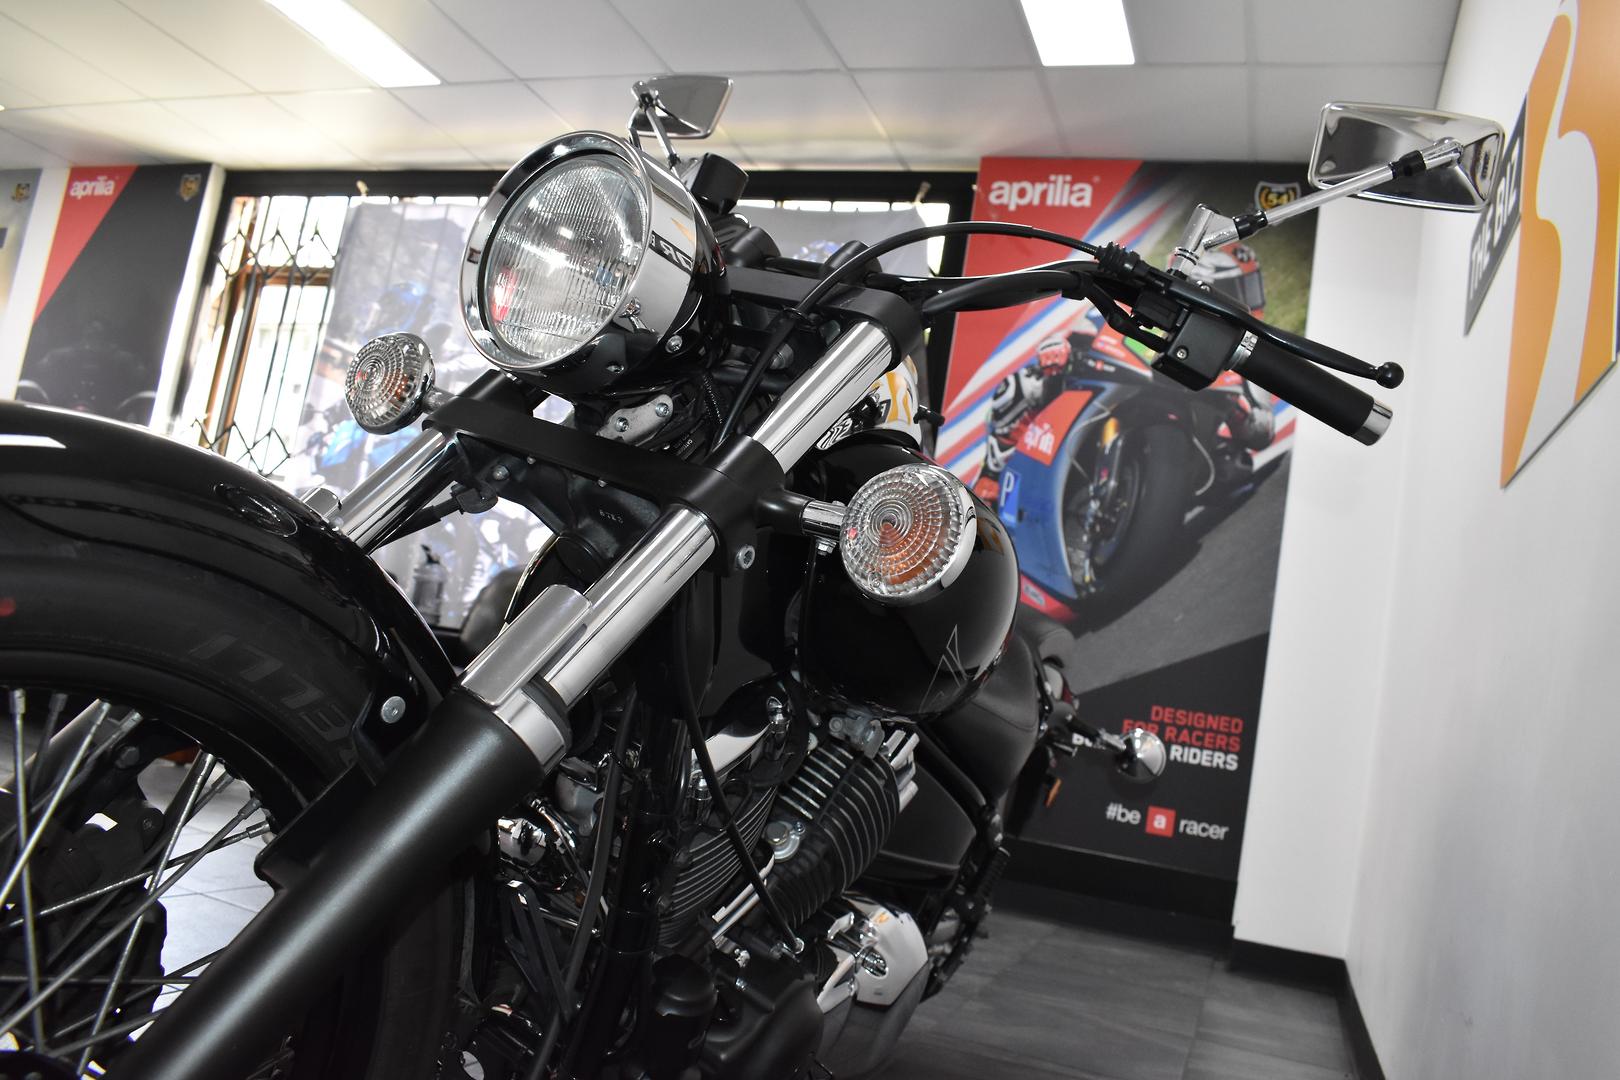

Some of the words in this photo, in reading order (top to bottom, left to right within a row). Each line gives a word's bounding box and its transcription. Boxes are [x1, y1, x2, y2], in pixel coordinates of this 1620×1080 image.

[69, 175, 116, 200] aprilia
[988, 174, 1093, 211] aprilia
[1493, 137, 1520, 249] BIZ
[187, 632, 356, 752] ELLI
[1151, 705, 1244, 734] DESIGNED
[1164, 727, 1241, 753] RACERS
[1169, 745, 1240, 771] RIDERS
[1105, 803, 1142, 825] #be
[1153, 814, 1167, 830] a
[1178, 818, 1230, 840] racer
